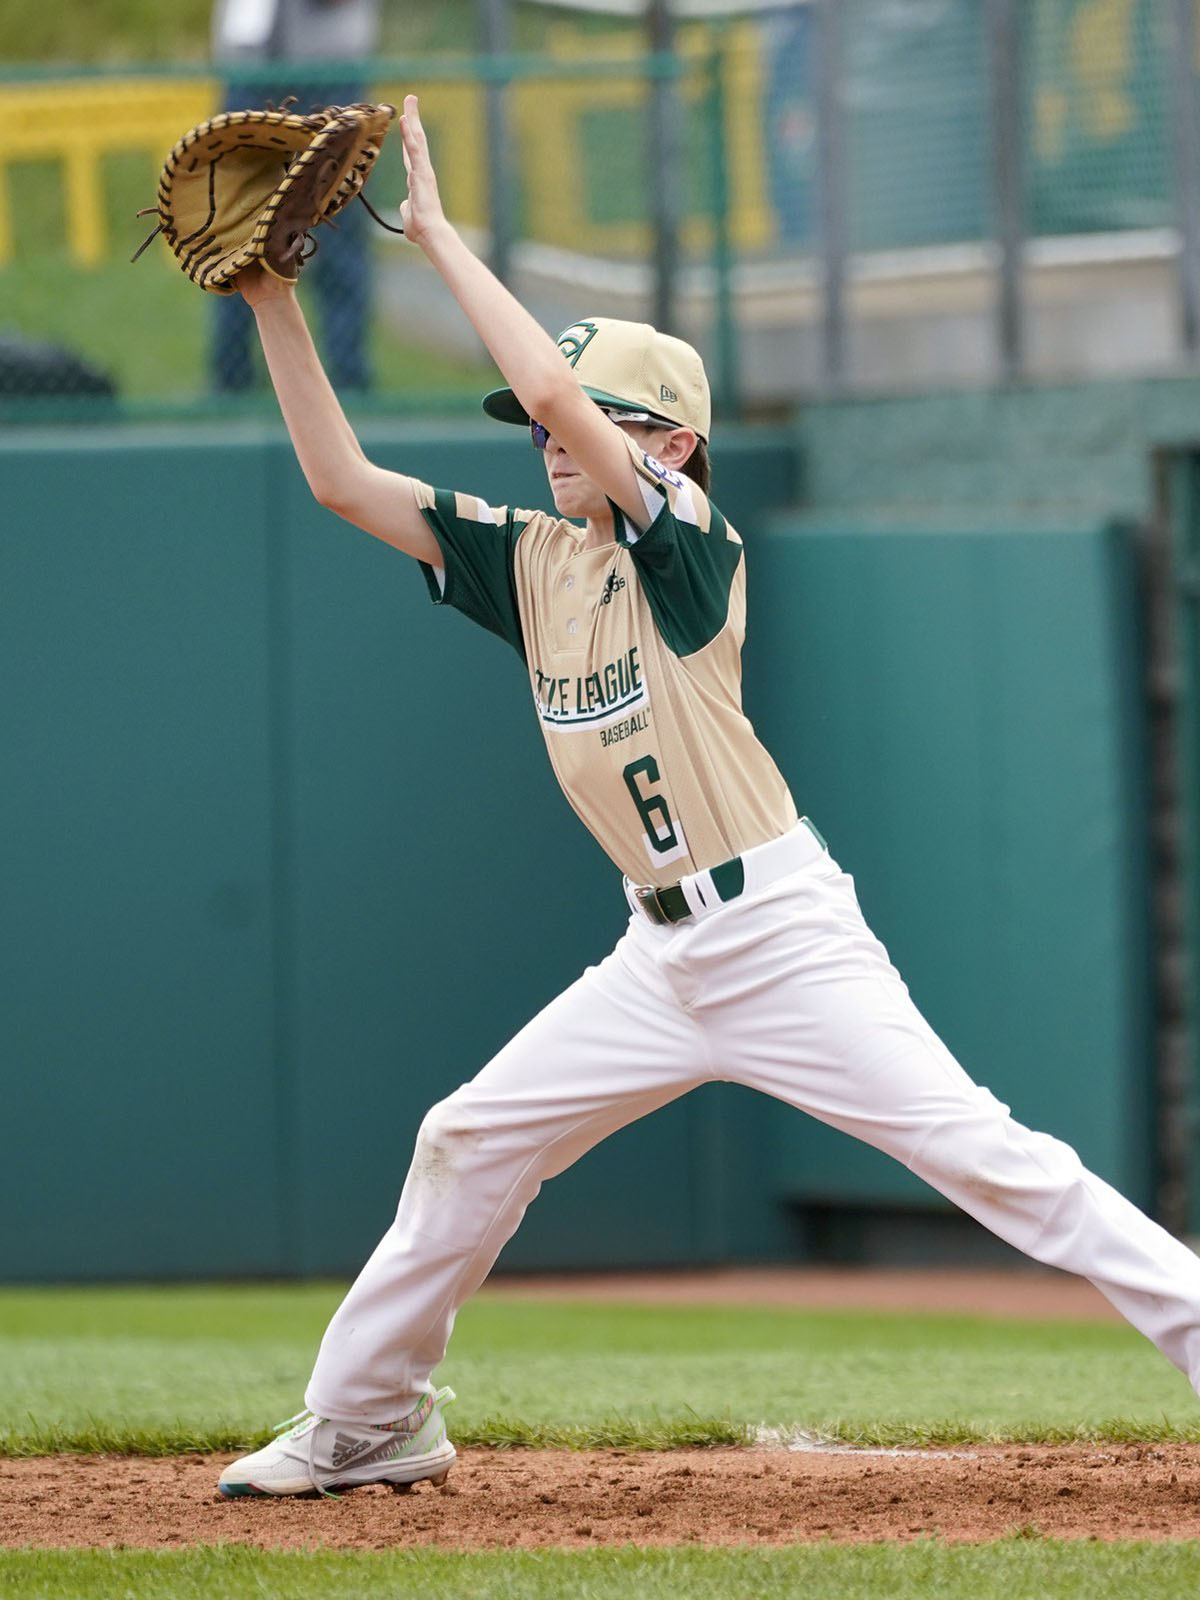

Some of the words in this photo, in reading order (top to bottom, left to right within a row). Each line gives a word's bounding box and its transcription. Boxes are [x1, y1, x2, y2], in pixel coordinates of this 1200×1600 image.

[576, 646, 642, 715] LEAGUE
[599, 711, 649, 748] BASEBALL
[622, 754, 679, 854] 6
[332, 1440, 372, 1467] adidas
